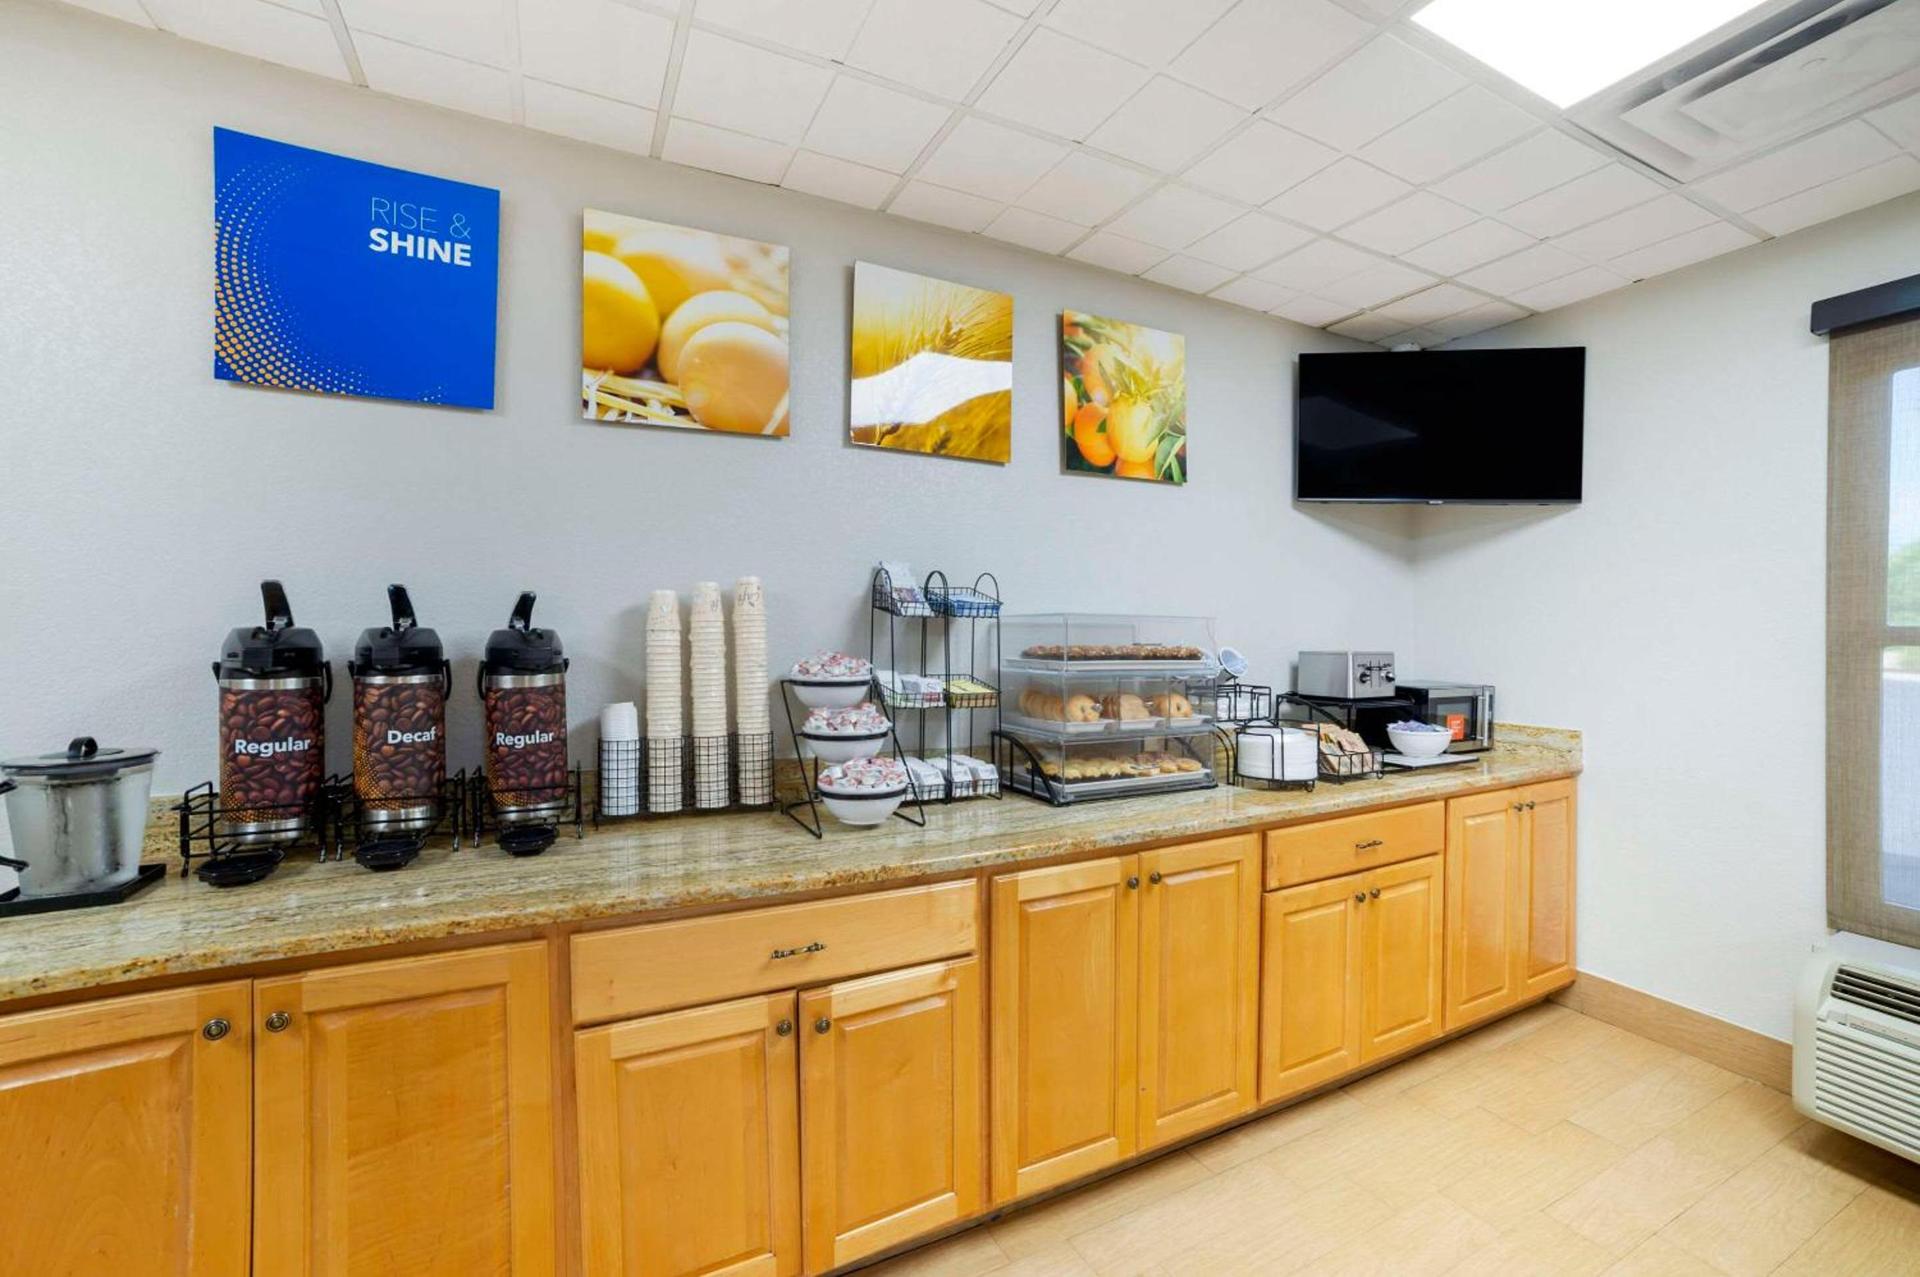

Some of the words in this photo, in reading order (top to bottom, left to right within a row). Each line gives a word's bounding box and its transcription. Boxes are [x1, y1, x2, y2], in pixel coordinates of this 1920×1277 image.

[371, 197, 437, 233] RISE
[449, 212, 472, 239] &
[368, 228, 471, 267] SHINE
[387, 726, 436, 745] Decaf
[496, 730, 554, 750] Regular
[234, 736, 311, 758] Regular
